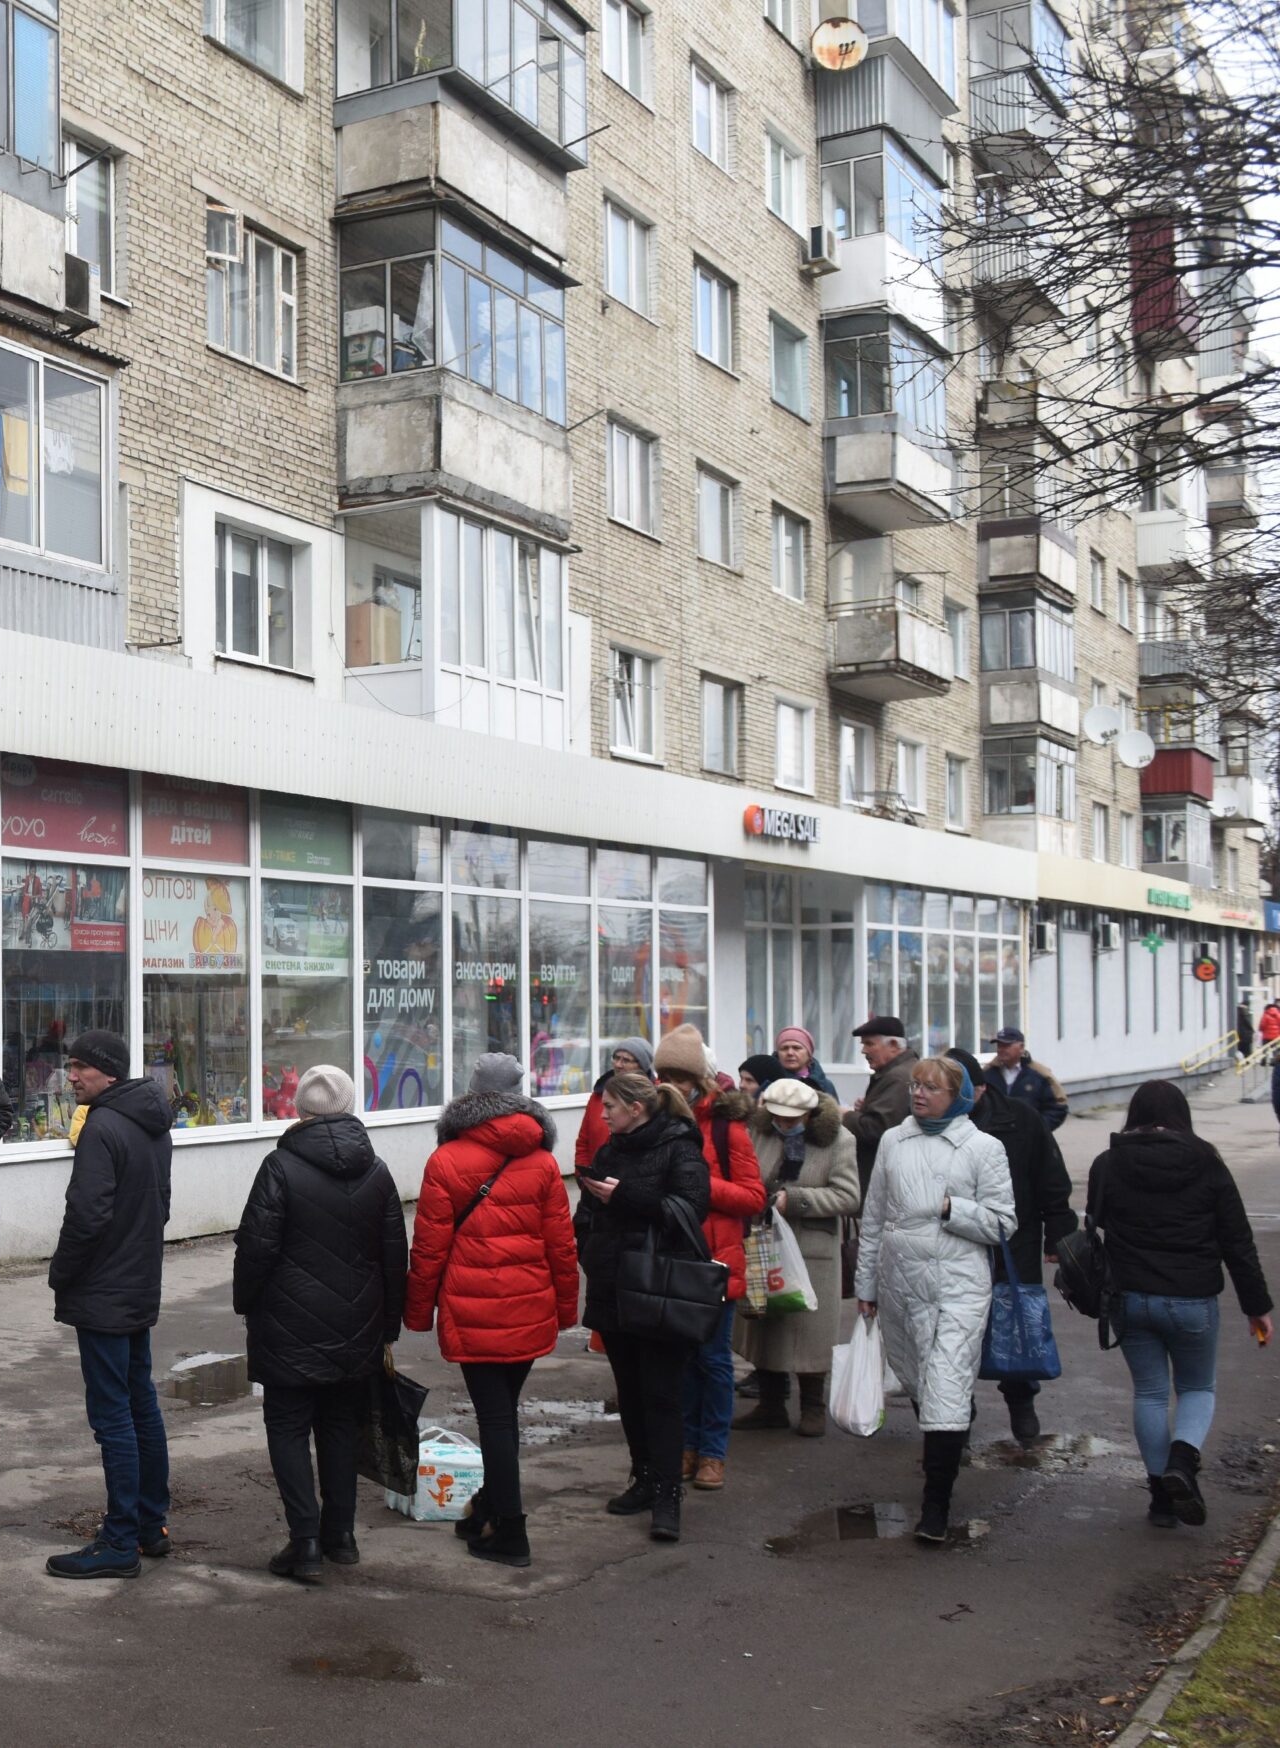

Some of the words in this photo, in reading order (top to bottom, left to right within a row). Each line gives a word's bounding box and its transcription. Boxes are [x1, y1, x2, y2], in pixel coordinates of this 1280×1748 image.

[170, 821, 212, 845] дітей
[763, 808, 797, 840] MEGA
[142, 876, 197, 901] ОПТОВІ
[143, 919, 179, 943] ЦІНИ
[143, 957, 185, 969] МАГАЗИН
[265, 960, 301, 971] СИСТЕМА
[377, 959, 425, 986] товари
[456, 962, 517, 987] аксесуари
[612, 965, 636, 987] одяг
[367, 988, 395, 1013] для
[398, 989, 436, 1013] дому
